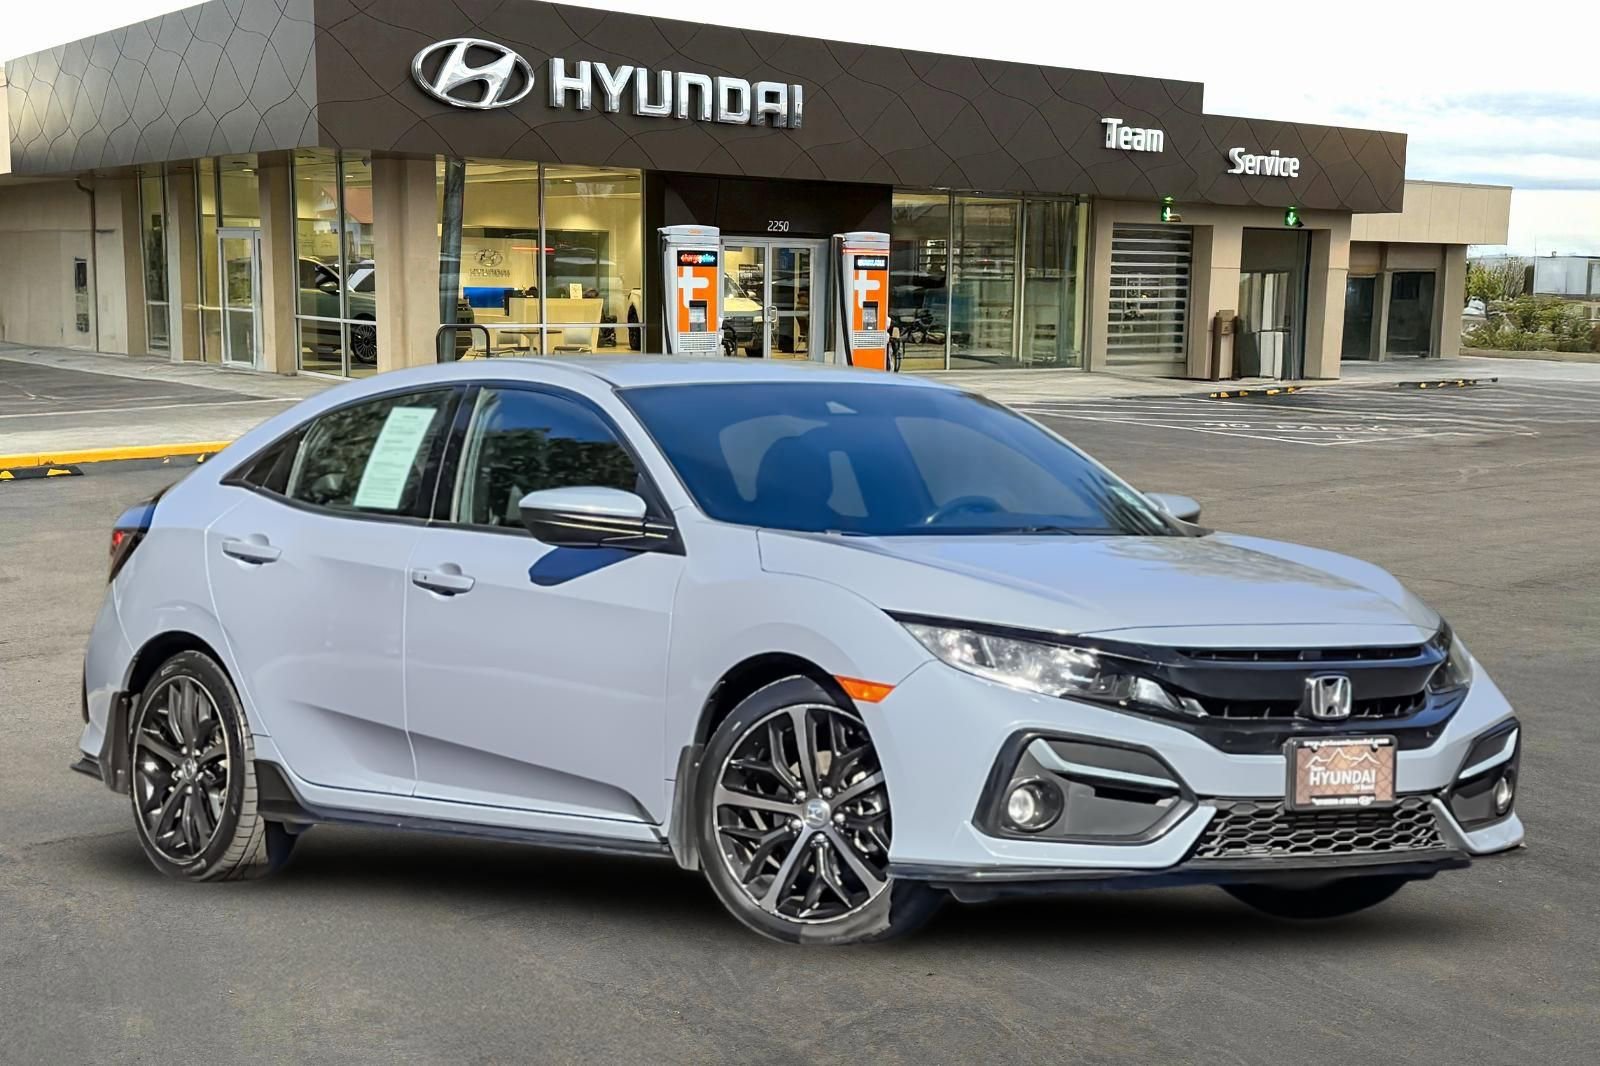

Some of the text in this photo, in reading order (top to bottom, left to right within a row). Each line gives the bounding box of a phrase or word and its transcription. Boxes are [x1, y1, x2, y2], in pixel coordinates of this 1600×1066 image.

[549, 57, 803, 129] HYUNDAI
[1101, 117, 1165, 153] Team
[1227, 147, 1300, 178] Service
[767, 220, 790, 232] 2250
[1309, 768, 1376, 786] HYUNDAI
